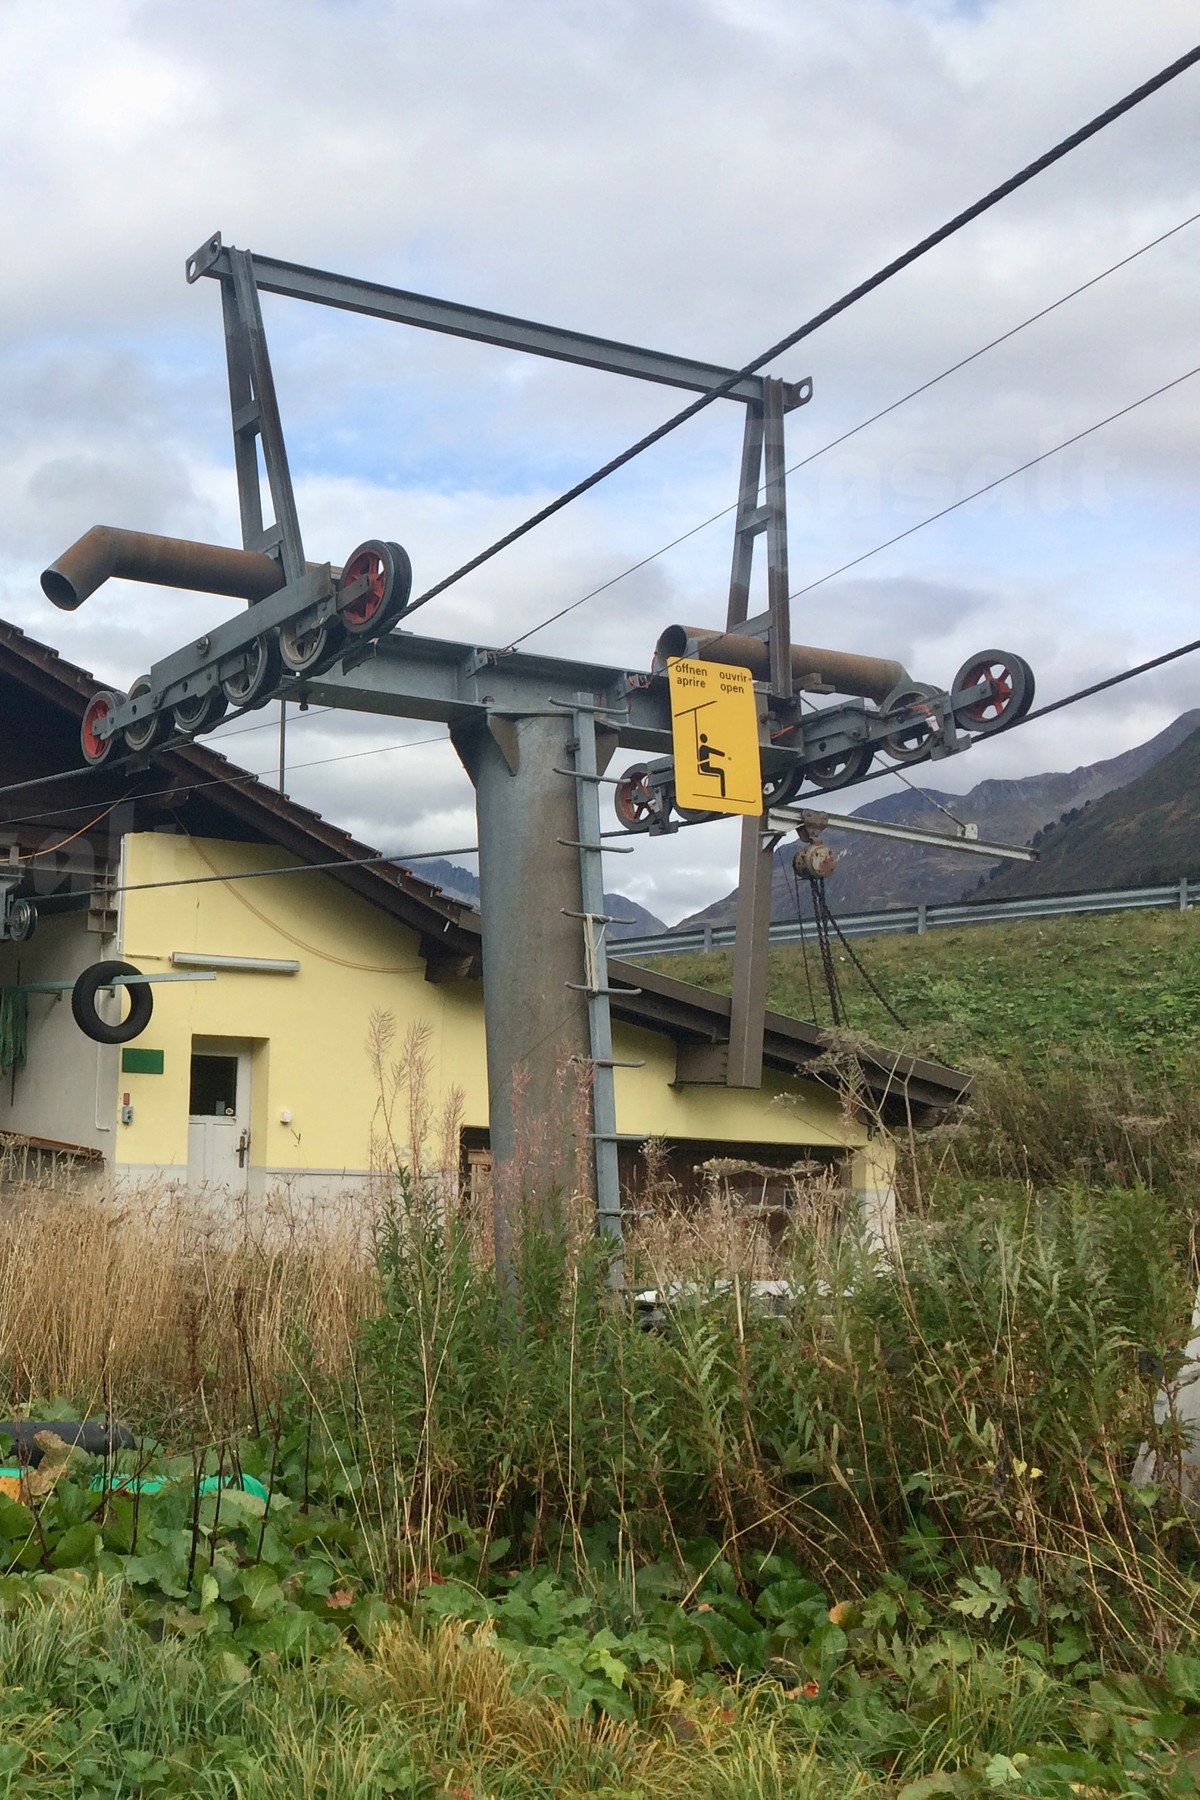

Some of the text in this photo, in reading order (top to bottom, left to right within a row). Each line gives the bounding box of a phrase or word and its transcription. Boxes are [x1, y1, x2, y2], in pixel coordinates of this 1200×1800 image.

[719, 671, 748, 683] ouvrir
[676, 676, 745, 694] aprire open
